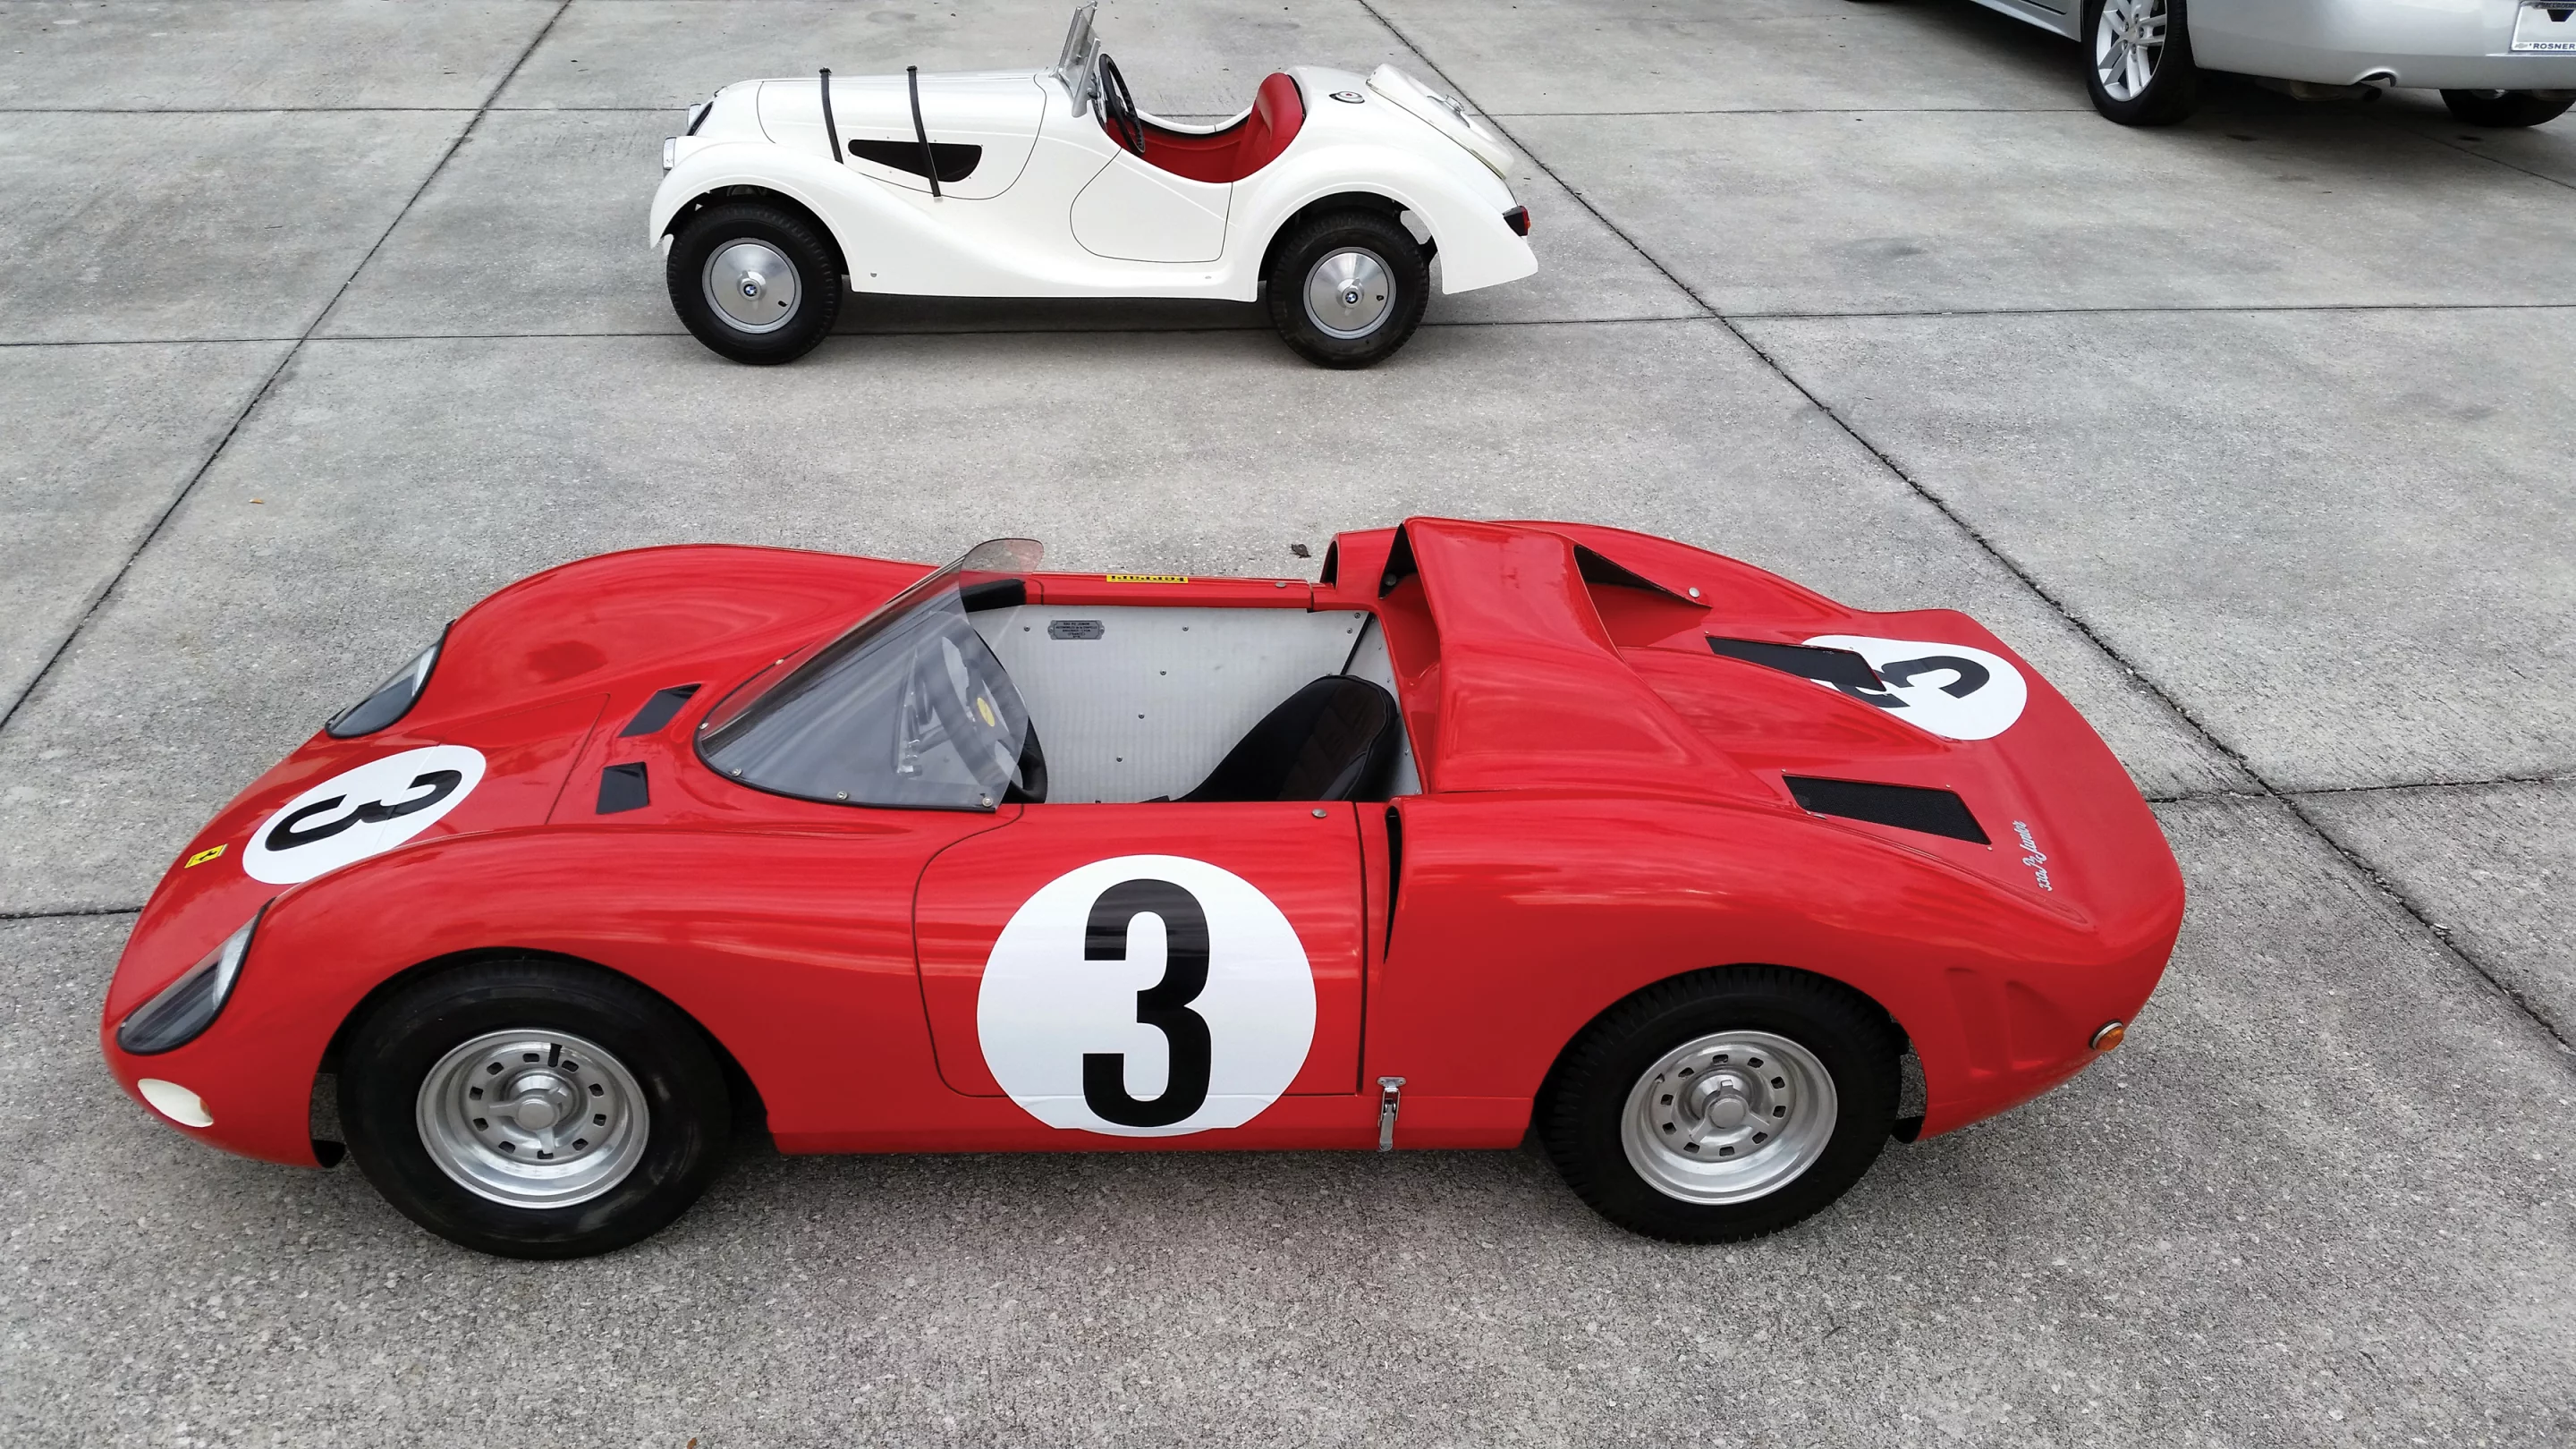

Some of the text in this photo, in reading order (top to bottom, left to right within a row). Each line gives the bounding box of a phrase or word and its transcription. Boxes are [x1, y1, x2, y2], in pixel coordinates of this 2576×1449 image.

[1834, 656, 1990, 708] 3
[265, 769, 462, 852] 3
[1083, 878, 1211, 1127] 3
